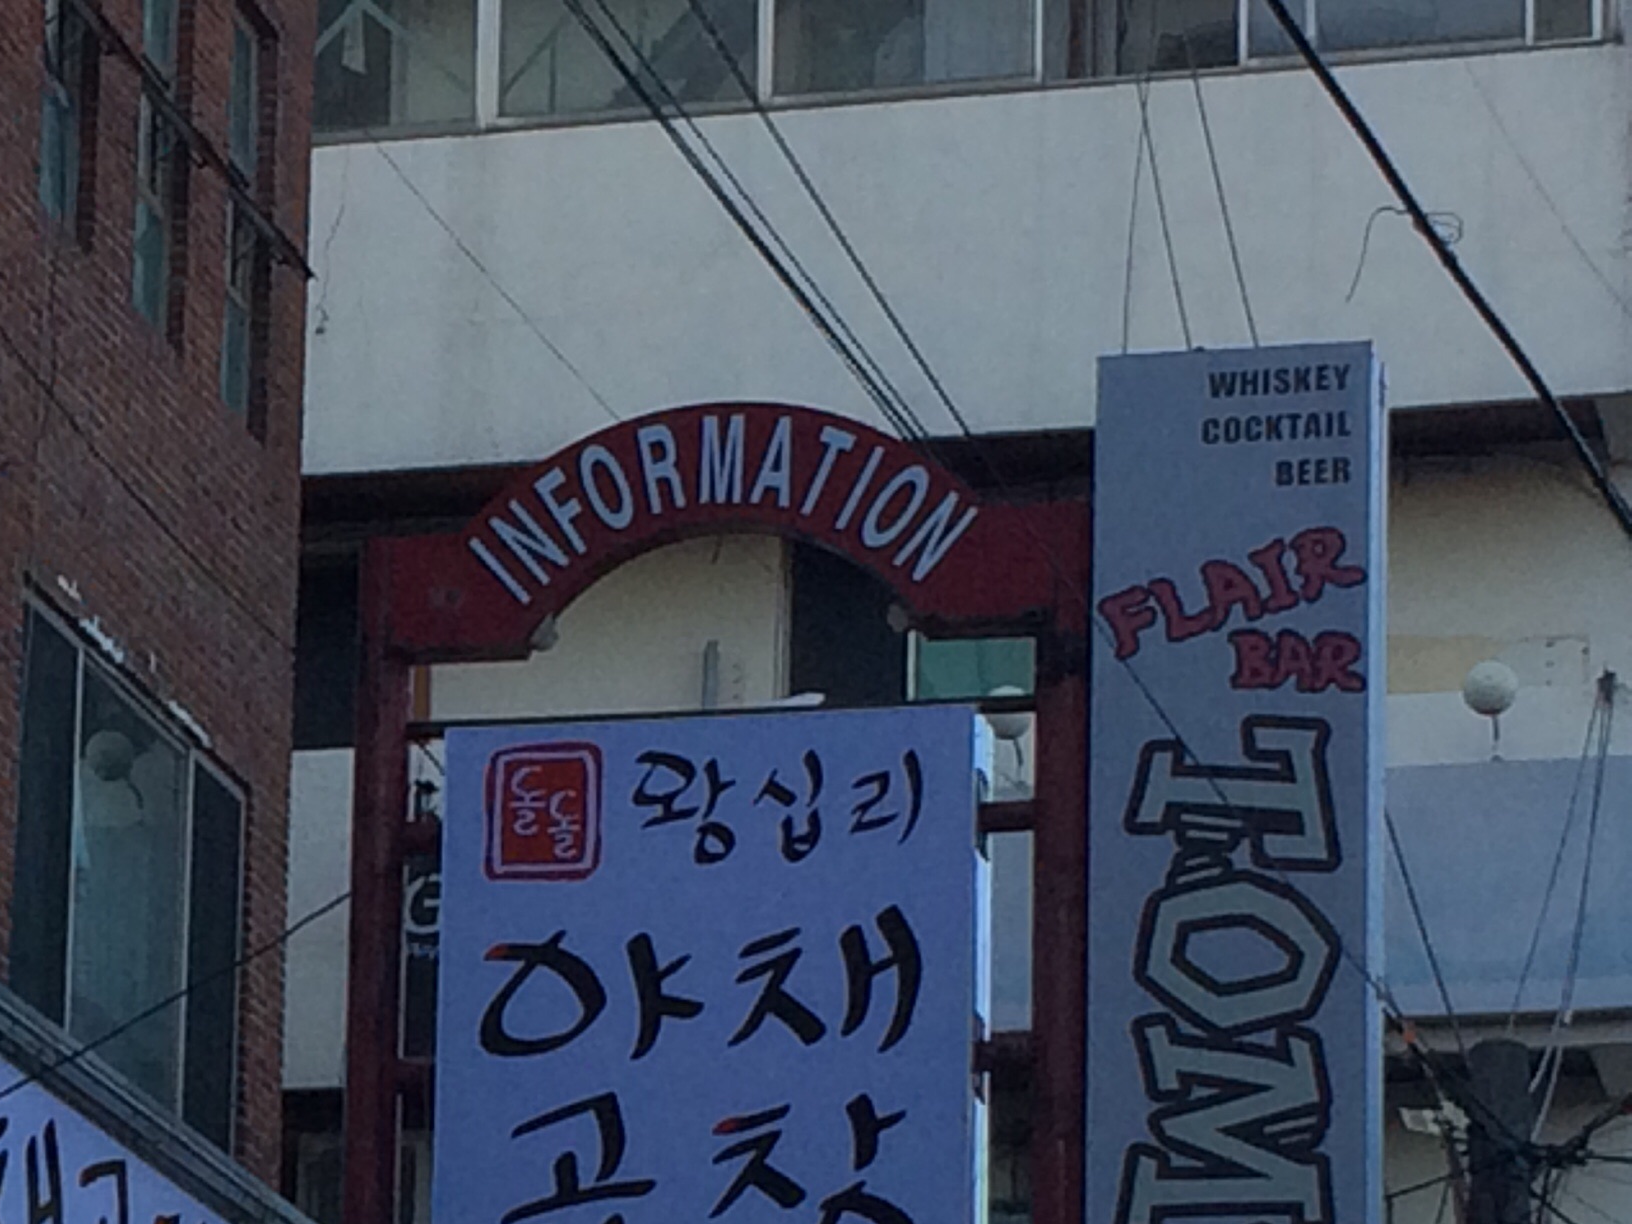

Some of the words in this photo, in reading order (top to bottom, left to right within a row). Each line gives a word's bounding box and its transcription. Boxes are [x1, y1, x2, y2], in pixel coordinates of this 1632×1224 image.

[1209, 364, 1352, 398] WHISKEY
[1200, 412, 1353, 444] COCKTAIL
[1274, 456, 1352, 486] BEER
[467, 411, 980, 606] INFORMATION
[1097, 525, 1369, 660] FLAIR
[1228, 628, 1369, 695] BAR
[630, 748, 924, 866] 왕십리
[477, 902, 923, 1060] 야채
